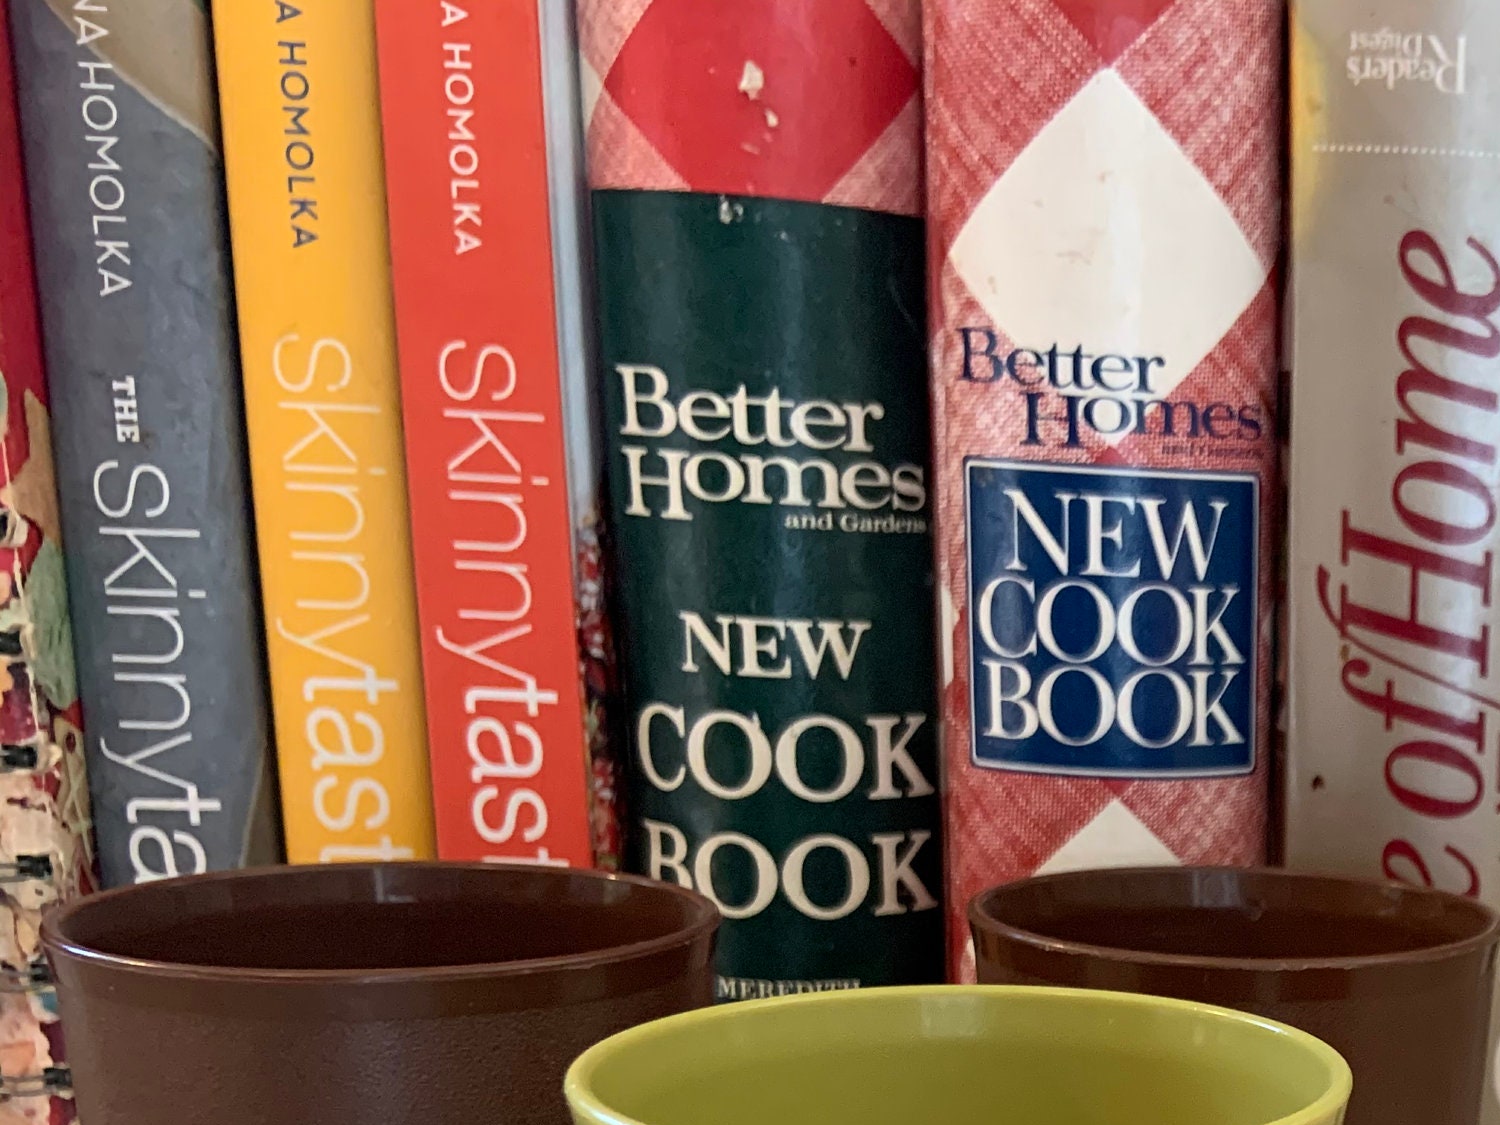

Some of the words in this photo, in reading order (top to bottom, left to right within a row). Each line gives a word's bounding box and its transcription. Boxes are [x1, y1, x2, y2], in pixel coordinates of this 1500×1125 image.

[77, 60, 133, 299] HOMOLKA
[277, 40, 320, 251] HOMOLKA
[442, 41, 482, 257] HOMOLKA
[957, 327, 1166, 394] Better
[111, 375, 140, 443] THE
[614, 362, 884, 453] Better
[1021, 390, 1263, 452] Homes
[620, 447, 926, 522] Homes
[784, 511, 834, 532] and
[839, 512, 927, 534] Gardens
[1003, 487, 1229, 580] NEW
[679, 611, 872, 682] NEW
[978, 579, 1245, 667] COOK
[981, 660, 1245, 751] BOOK
[1341, 657, 1486, 820] of
[637, 701, 936, 803] COOK
[642, 816, 941, 921] BOOK
